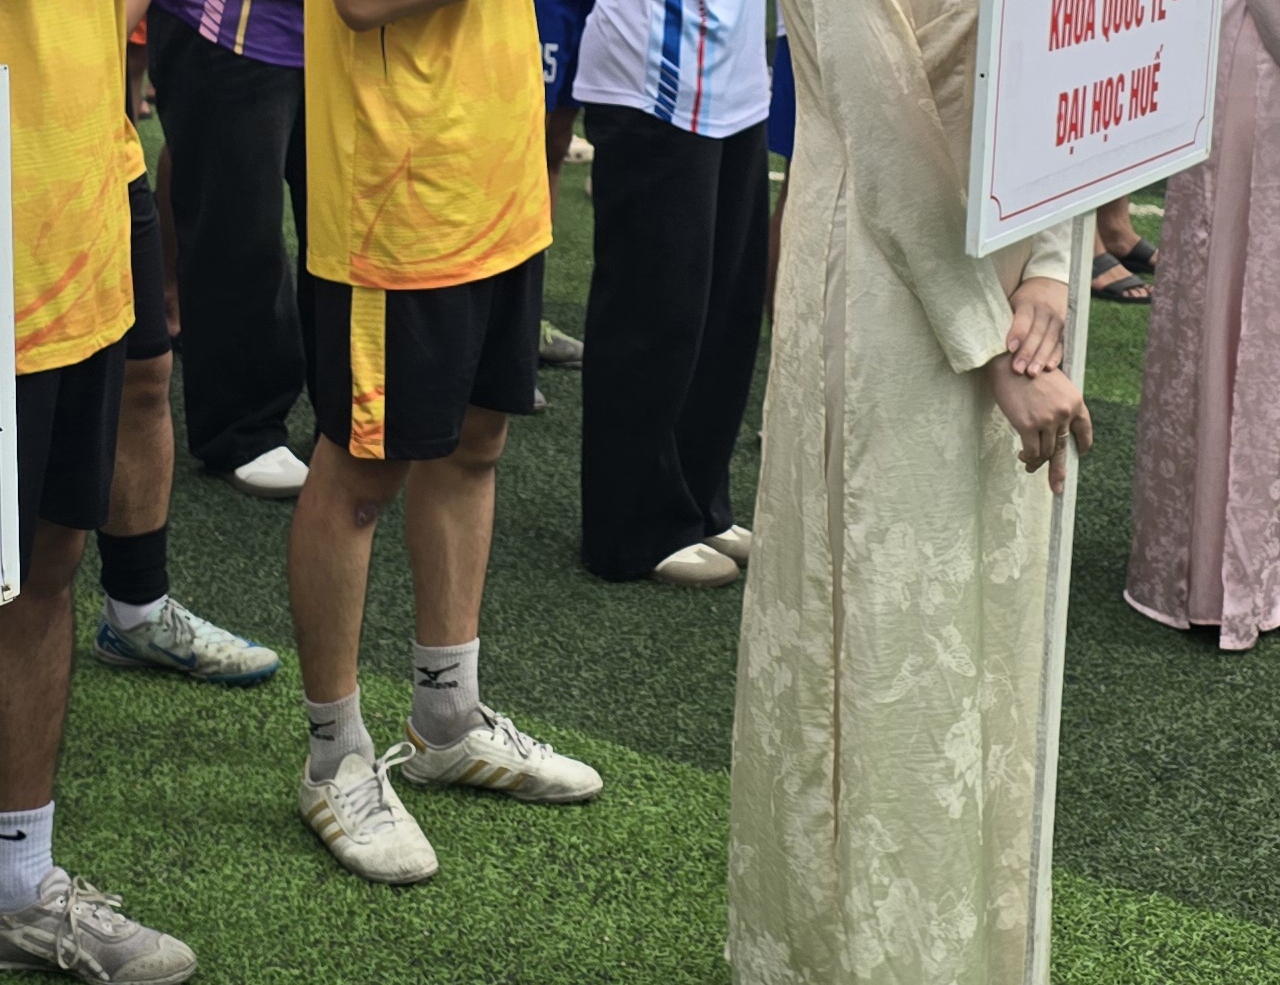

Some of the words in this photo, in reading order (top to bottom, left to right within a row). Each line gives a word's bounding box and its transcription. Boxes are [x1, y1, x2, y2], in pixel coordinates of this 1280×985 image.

[1056, 85, 1087, 154] ĐẠI
[1090, 73, 1125, 142] HỌC
[1128, 44, 1163, 124] HUẾ
